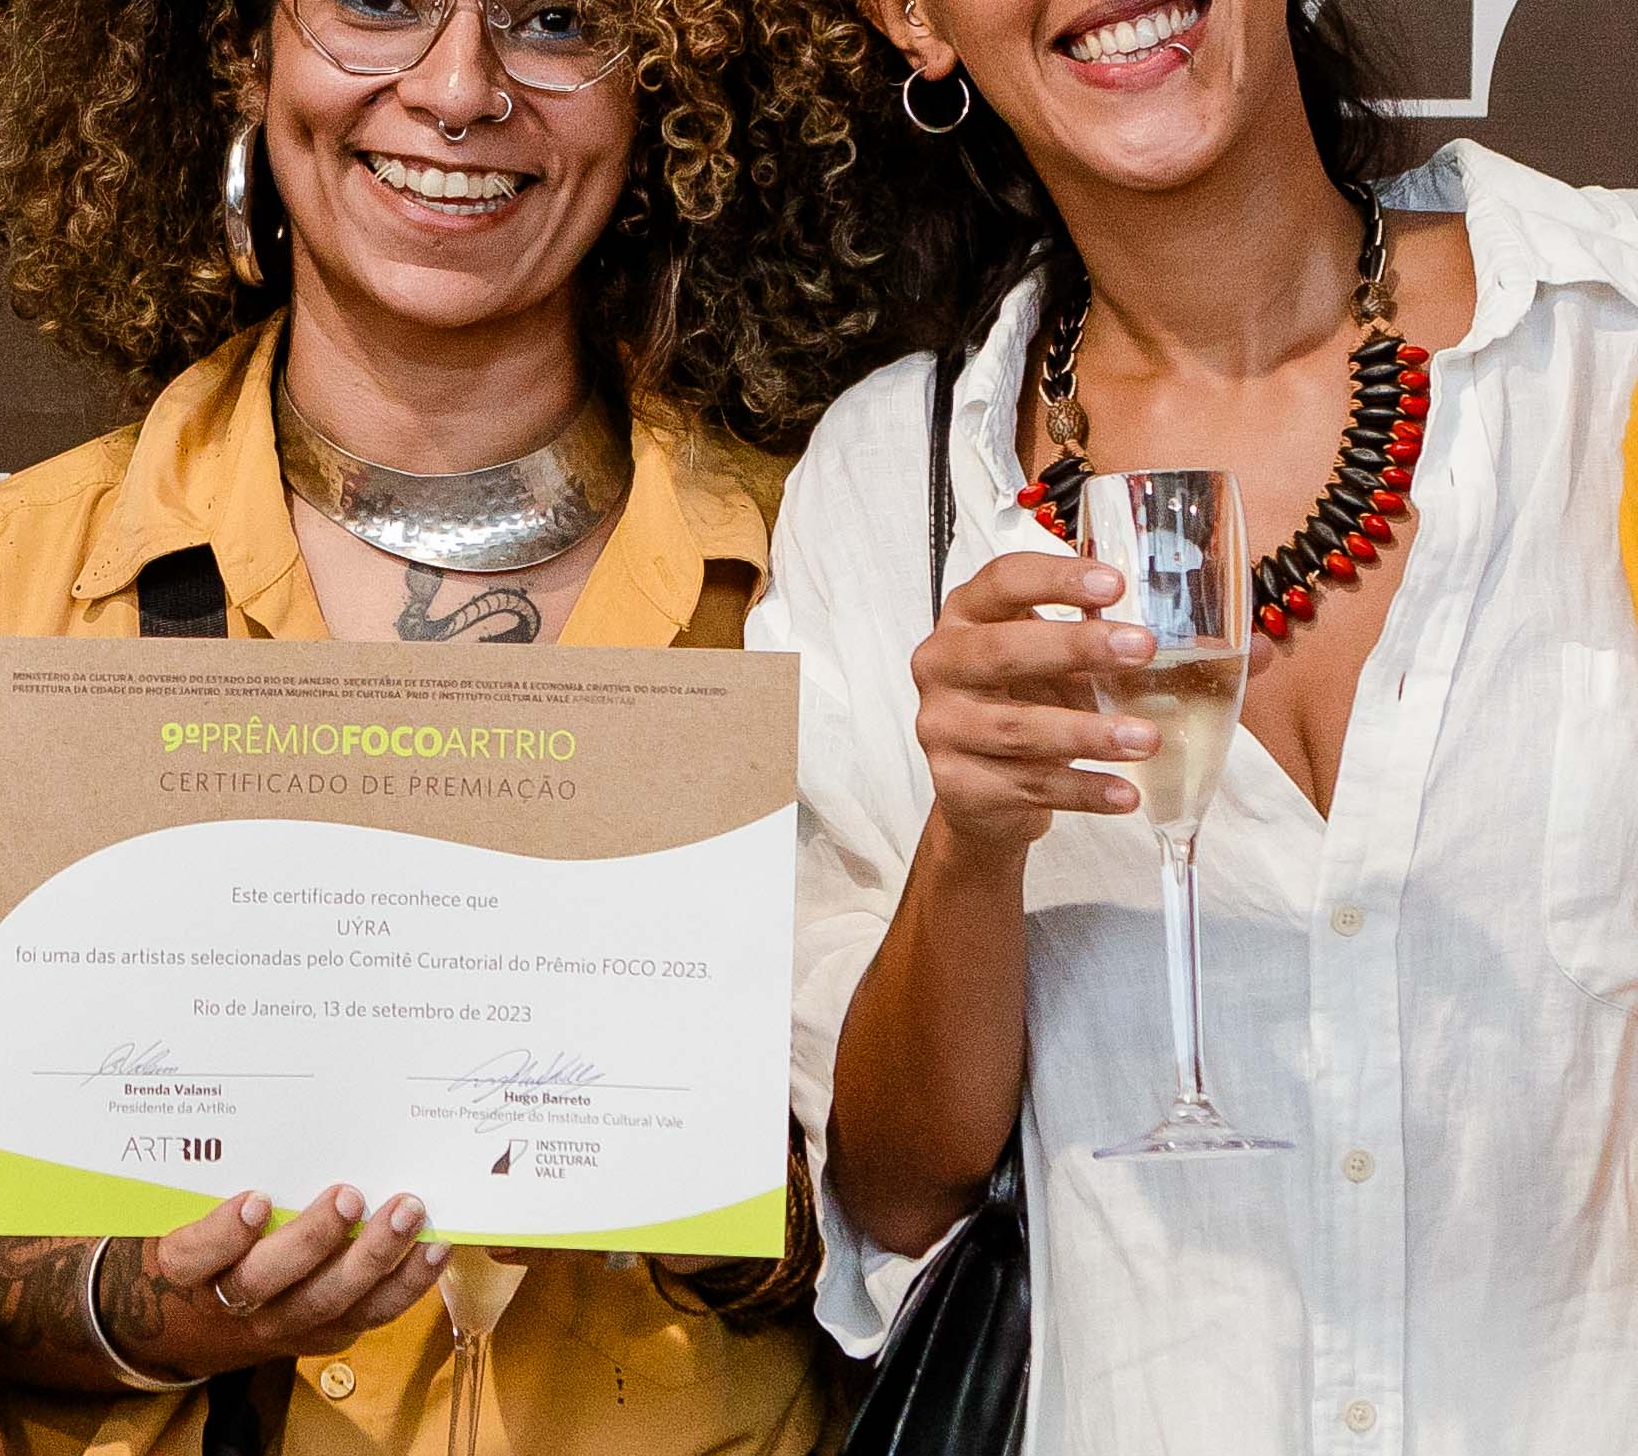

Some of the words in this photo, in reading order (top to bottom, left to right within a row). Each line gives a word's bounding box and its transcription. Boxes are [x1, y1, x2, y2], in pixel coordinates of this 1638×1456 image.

[158, 770, 348, 795] CERTIFICADO
[360, 773, 395, 796] DE
[408, 773, 576, 804] PREMIAÇÃO
[231, 885, 269, 904] Este
[272, 886, 366, 905] certificado
[369, 888, 461, 907] reconhece
[464, 894, 499, 911] que
[336, 915, 391, 936] UÝRA
[15, 944, 37, 963] foi
[41, 949, 80, 964] uma
[84, 946, 116, 964] das
[120, 948, 186, 965] artistas
[189, 947, 302, 967] selecionadas
[305, 948, 344, 969] pelo
[348, 949, 412, 969] Comitê
[416, 951, 503, 971] Curatorial
[506, 953, 530, 972] do
[534, 954, 597, 975] Prêmio
[601, 957, 656, 977] FOCO
[660, 959, 712, 979] 2023.
[192, 998, 221, 1016] Rio
[224, 997, 247, 1016] de
[250, 998, 316, 1019] Janeiro,
[322, 999, 340, 1017] 13
[344, 999, 367, 1018] de
[371, 1001, 455, 1020] setembro
[458, 1002, 481, 1021] de
[485, 1003, 532, 1023] 2023
